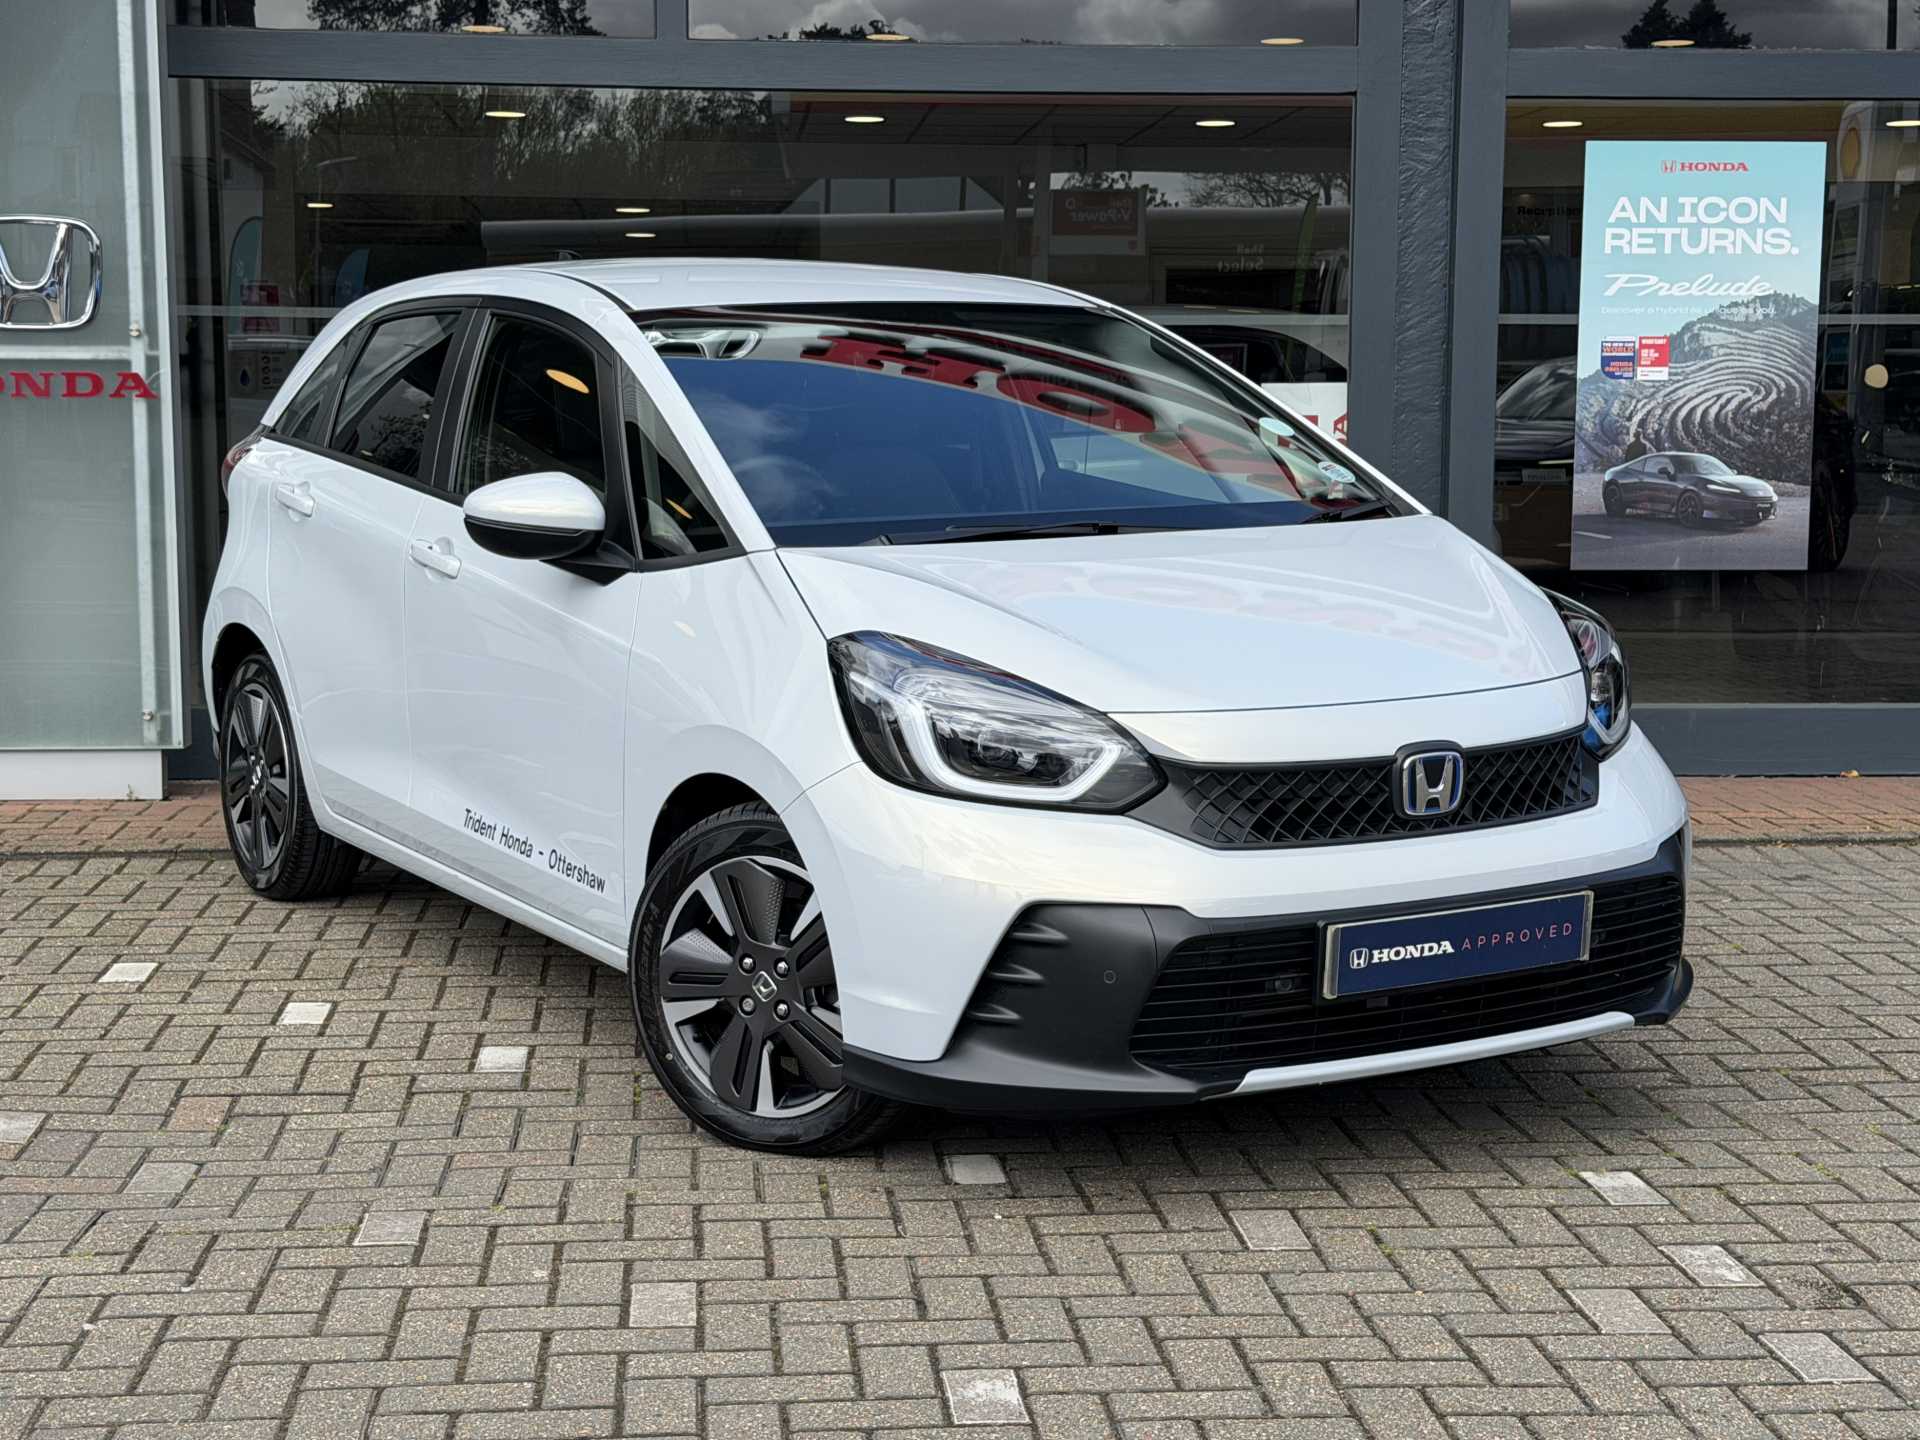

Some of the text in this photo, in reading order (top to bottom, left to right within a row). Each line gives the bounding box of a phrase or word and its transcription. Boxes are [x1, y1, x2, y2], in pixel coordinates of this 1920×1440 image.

[1679, 162, 1749, 172] HONDA
[1607, 196, 1788, 225] AN ICON
[1603, 227, 1800, 256] RETURNS.
[1603, 272, 1775, 297] Prelude
[0, 370, 160, 399] NDA
[463, 807, 498, 842] Trident
[499, 825, 534, 859] Honda
[548, 848, 607, 894] Ottershaw
[1371, 921, 1574, 965] HONDA APPROVED
